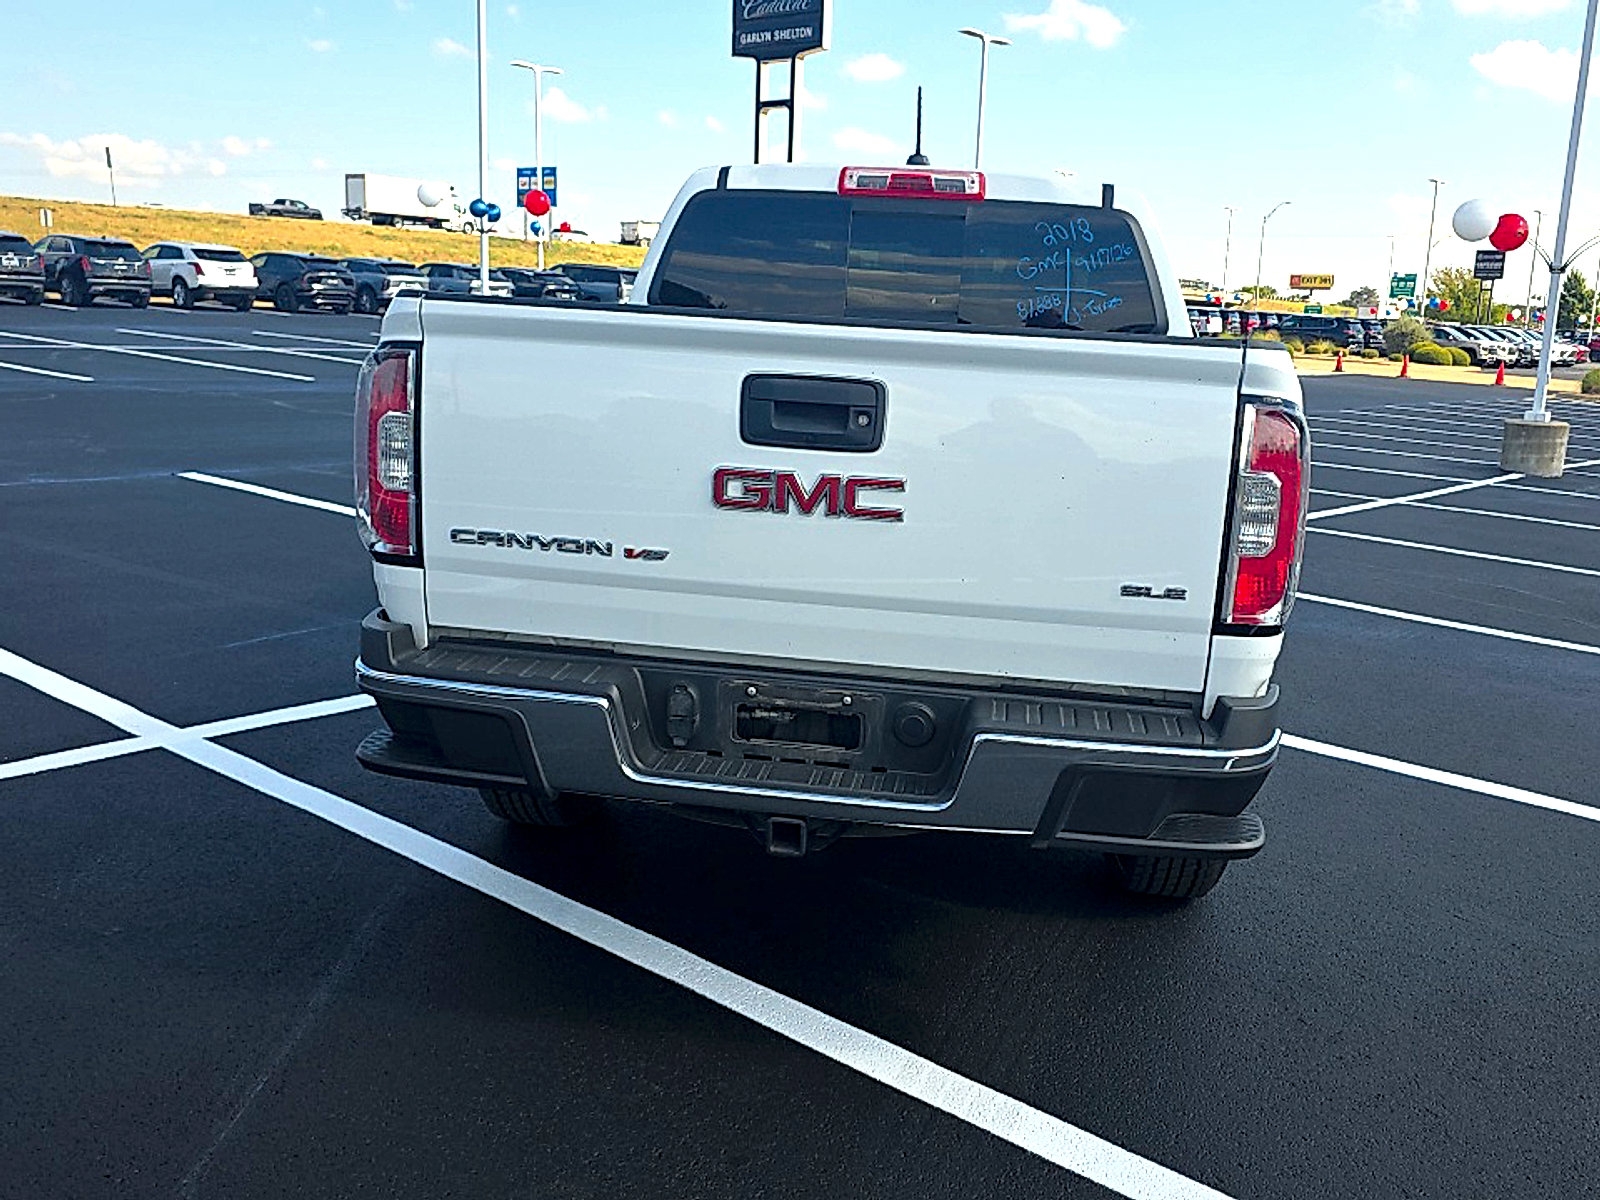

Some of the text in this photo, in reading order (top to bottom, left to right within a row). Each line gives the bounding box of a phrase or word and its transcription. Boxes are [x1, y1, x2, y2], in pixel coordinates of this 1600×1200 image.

[773, 26, 813, 42] SHELTON
[1035, 217, 1094, 246] 2018
[711, 465, 907, 523] GMC
[449, 528, 613, 557] CANYON
[1120, 585, 1188, 600] SLE
